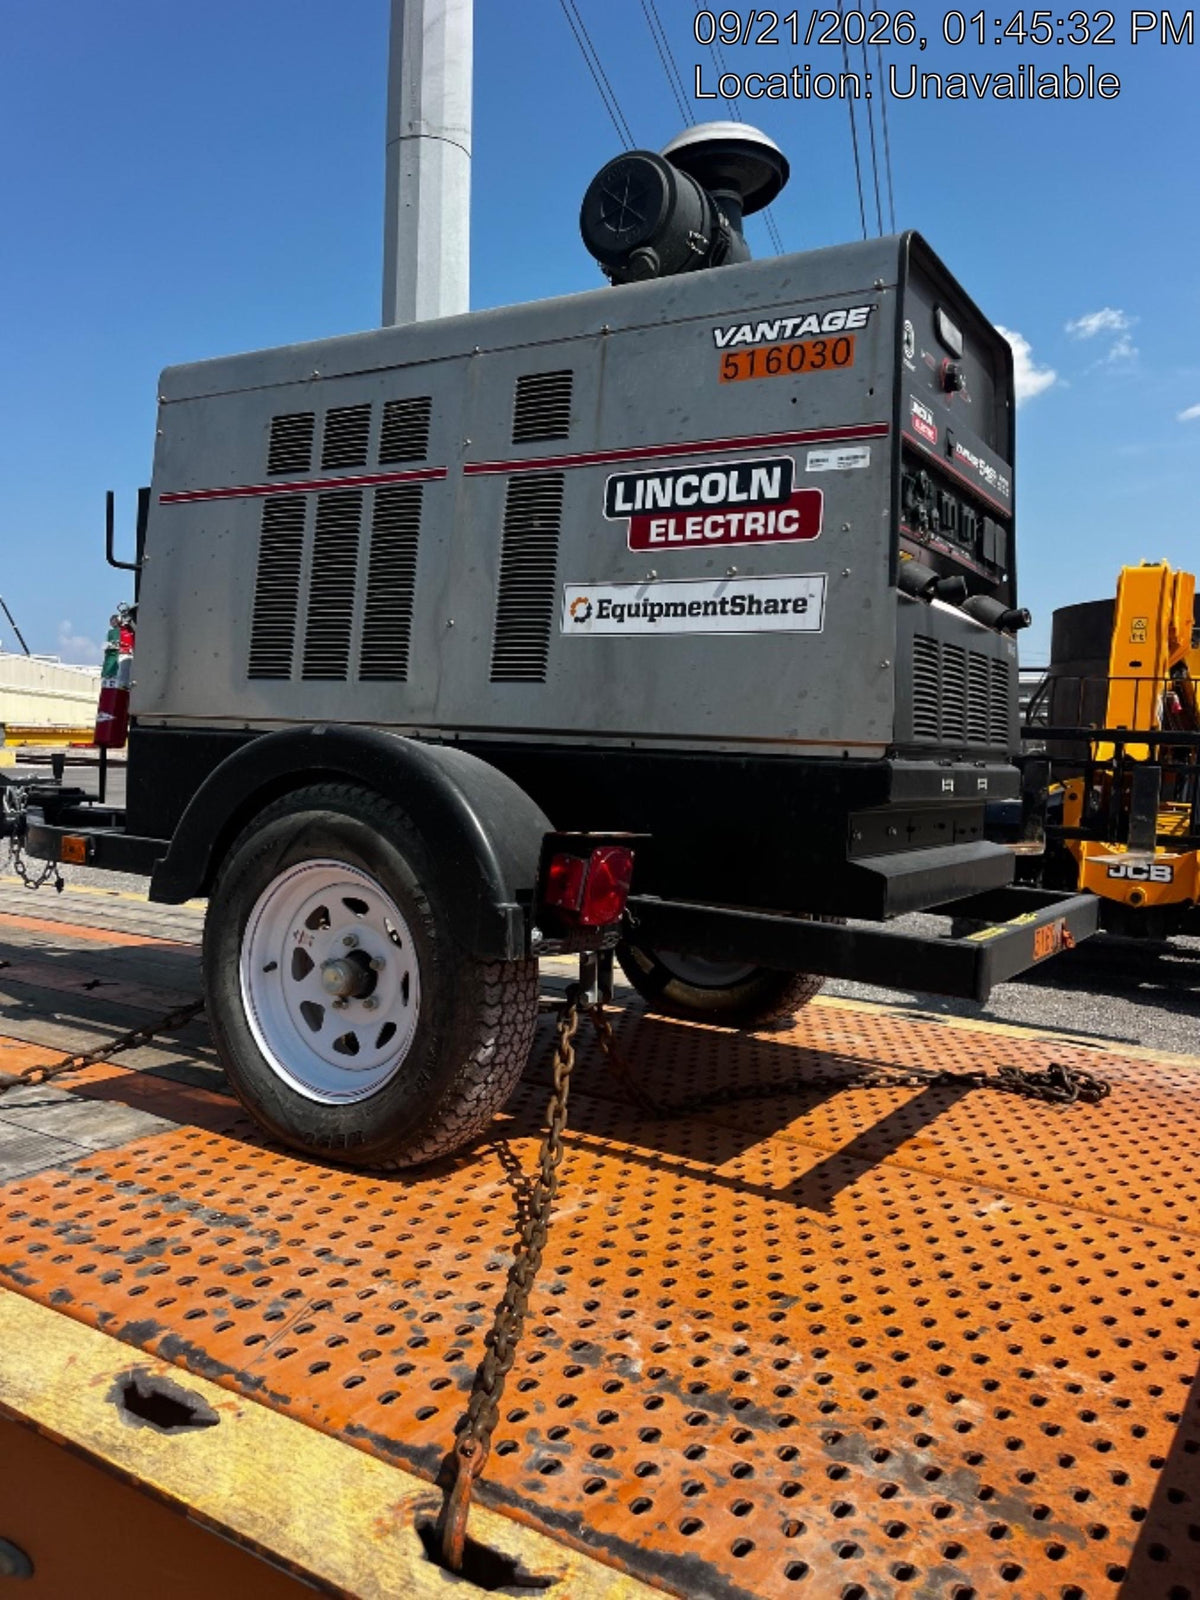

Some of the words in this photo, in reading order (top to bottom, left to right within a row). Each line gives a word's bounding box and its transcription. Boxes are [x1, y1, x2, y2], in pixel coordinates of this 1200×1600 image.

[713, 305, 870, 348] VANTAGE
[723, 337, 851, 380] 516030
[614, 466, 782, 513] LINCOLN
[649, 509, 800, 543] ELECTRIC
[596, 595, 808, 623] EquipmentShare
[1109, 864, 1171, 882] JCB
